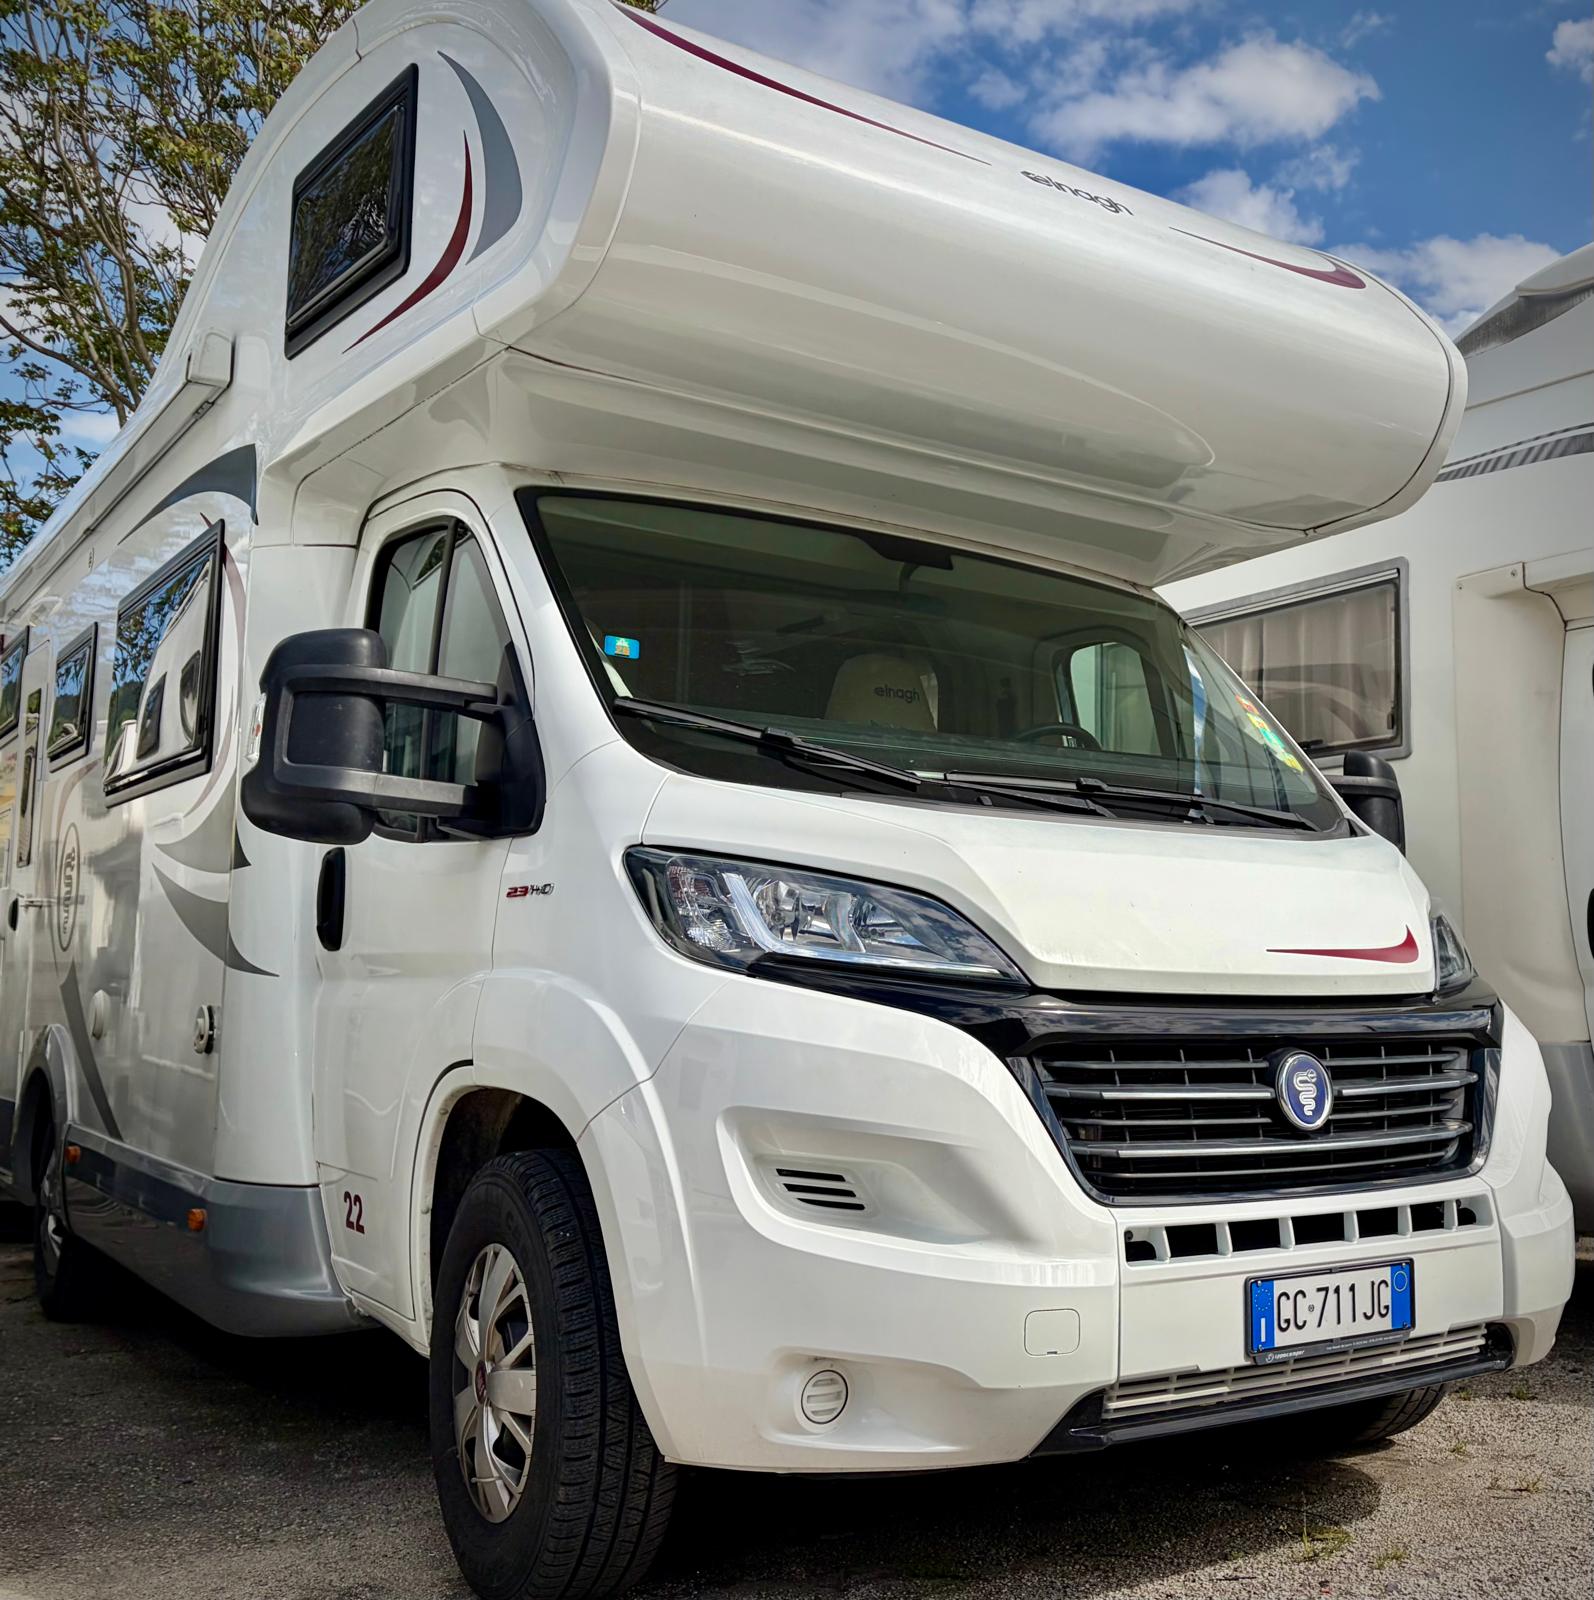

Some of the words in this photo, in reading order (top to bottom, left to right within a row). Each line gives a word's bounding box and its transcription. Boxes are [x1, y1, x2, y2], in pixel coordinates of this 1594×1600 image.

[1020, 170, 1134, 216] elnagh
[873, 684, 920, 704] elnagh
[343, 1190, 365, 1235] 22
